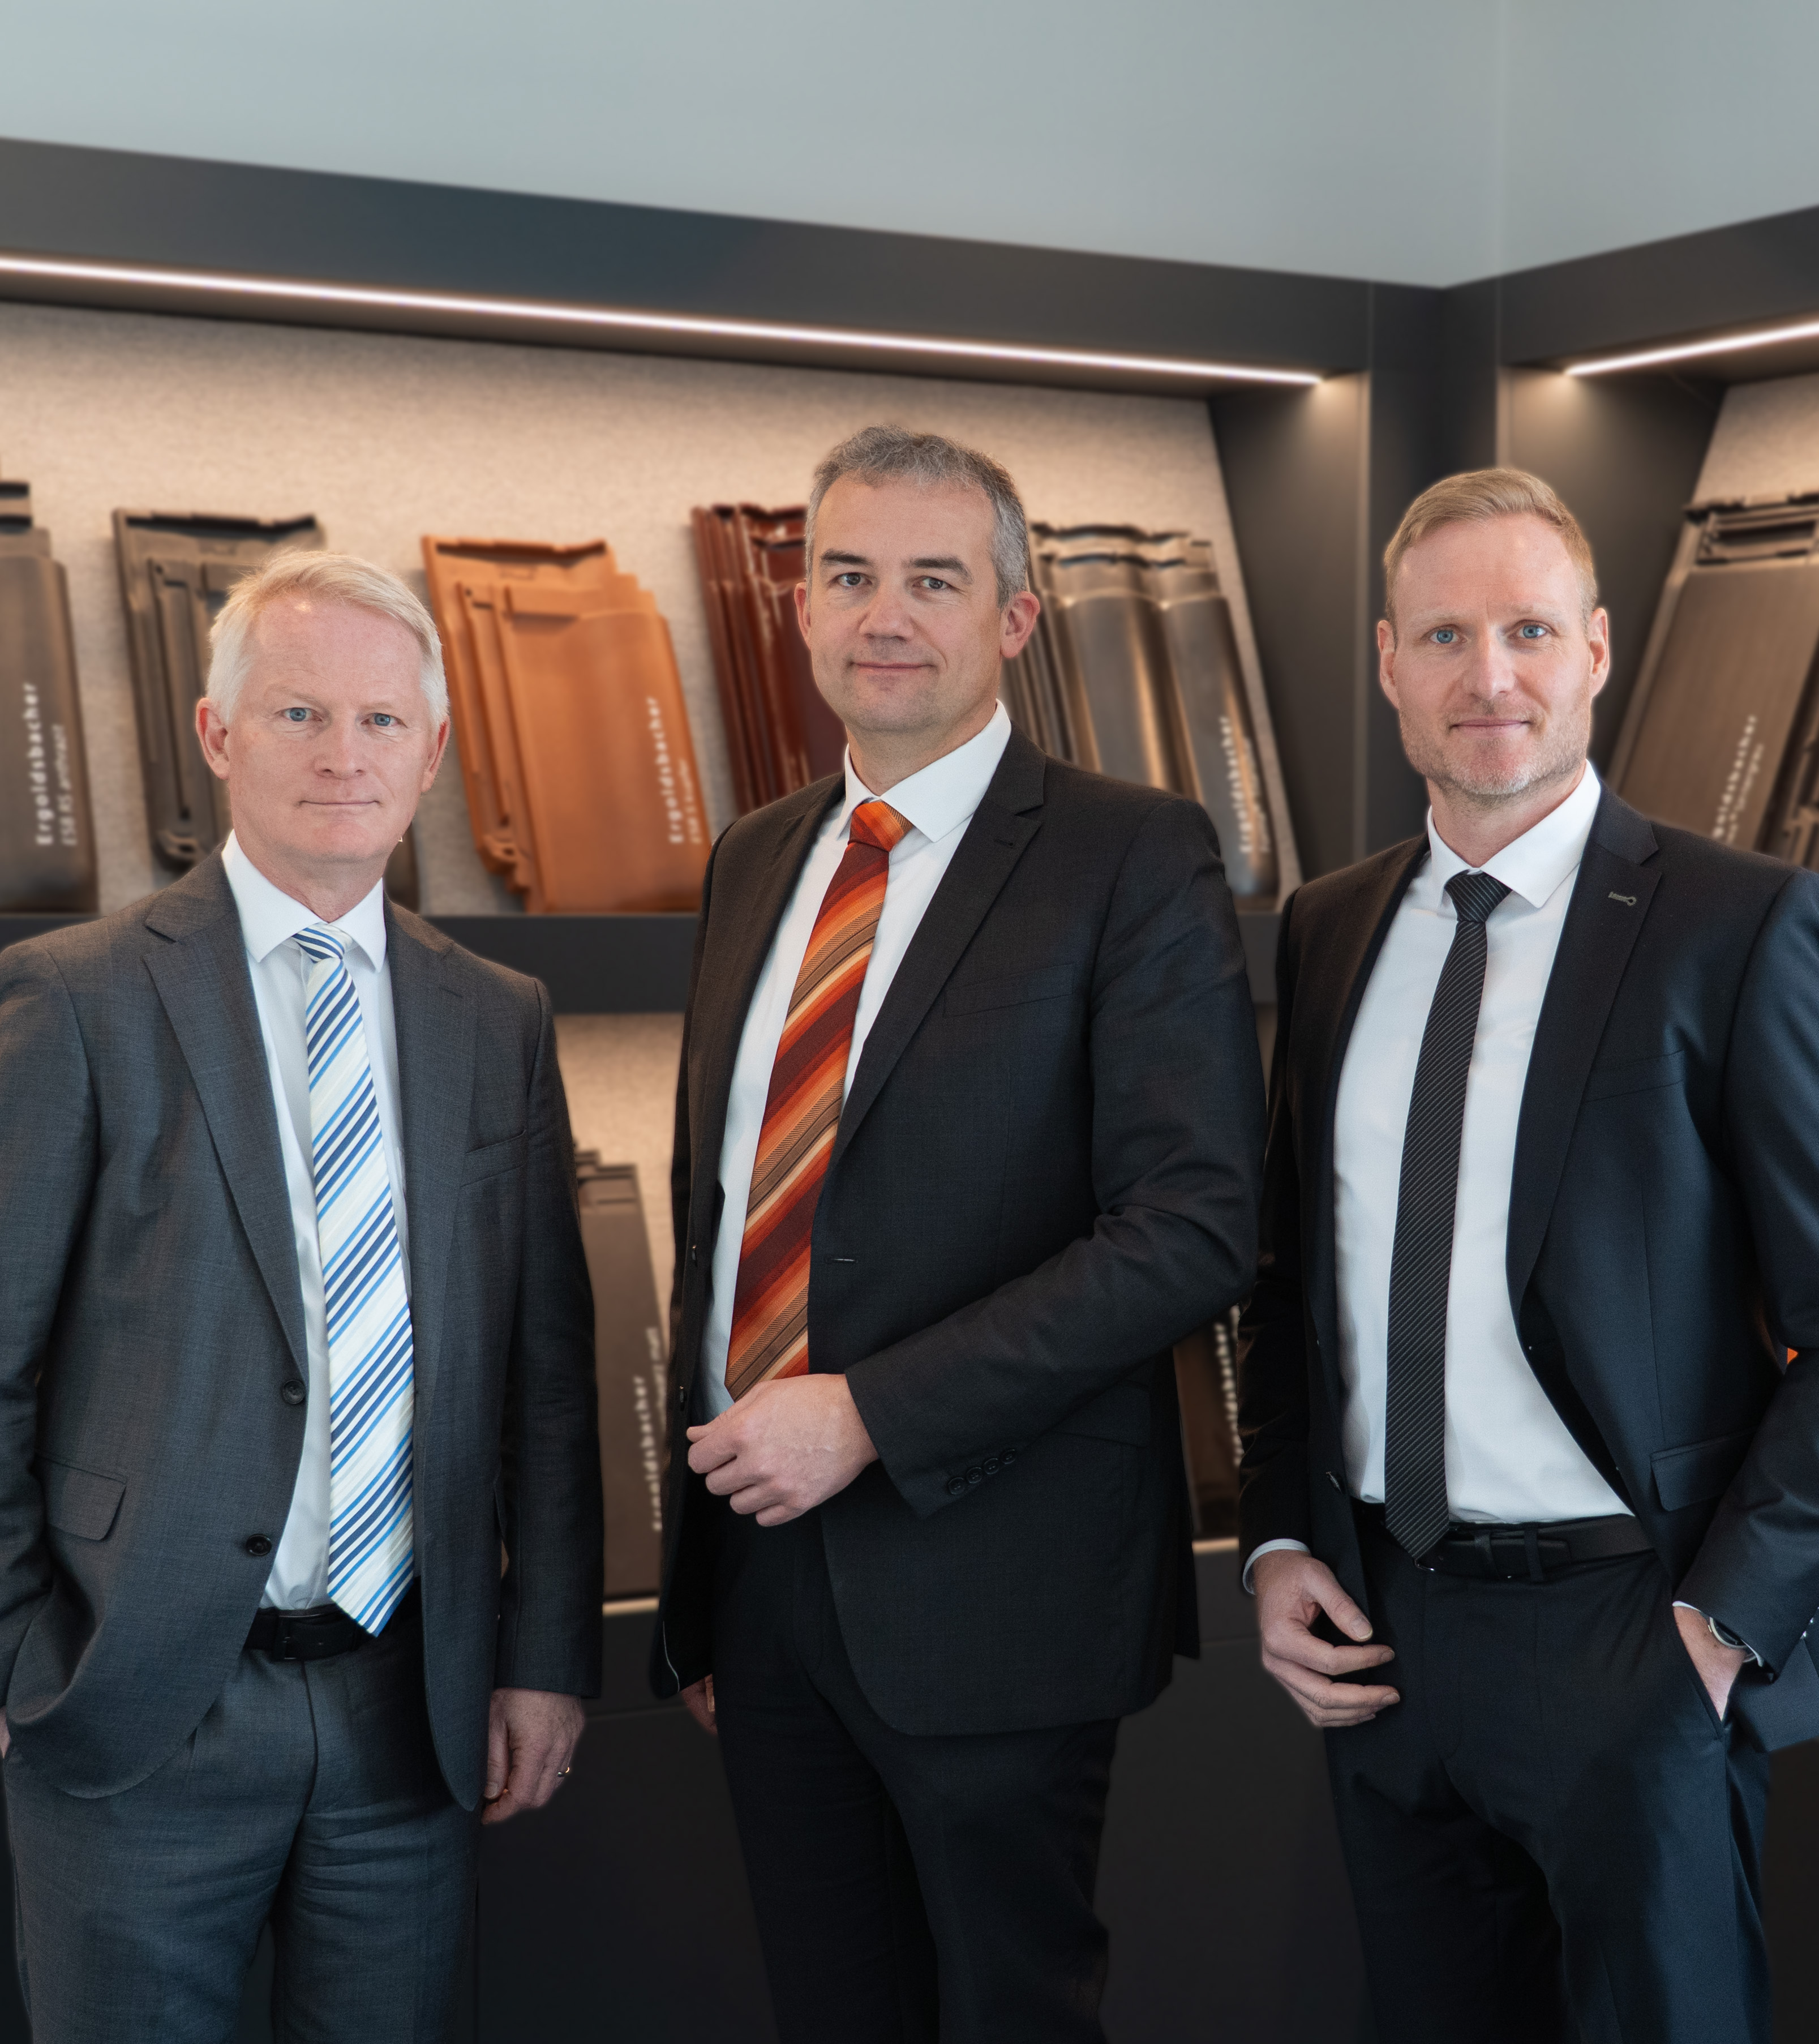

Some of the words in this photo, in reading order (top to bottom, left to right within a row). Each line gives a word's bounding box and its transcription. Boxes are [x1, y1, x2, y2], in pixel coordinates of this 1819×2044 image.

[22, 682, 54, 845] Ergoldsbacher
[647, 697, 685, 844] Ergoldsbacher
[1219, 716, 1253, 854] Ergoldsbacher
[1711, 715, 1757, 839] goldsbacher
